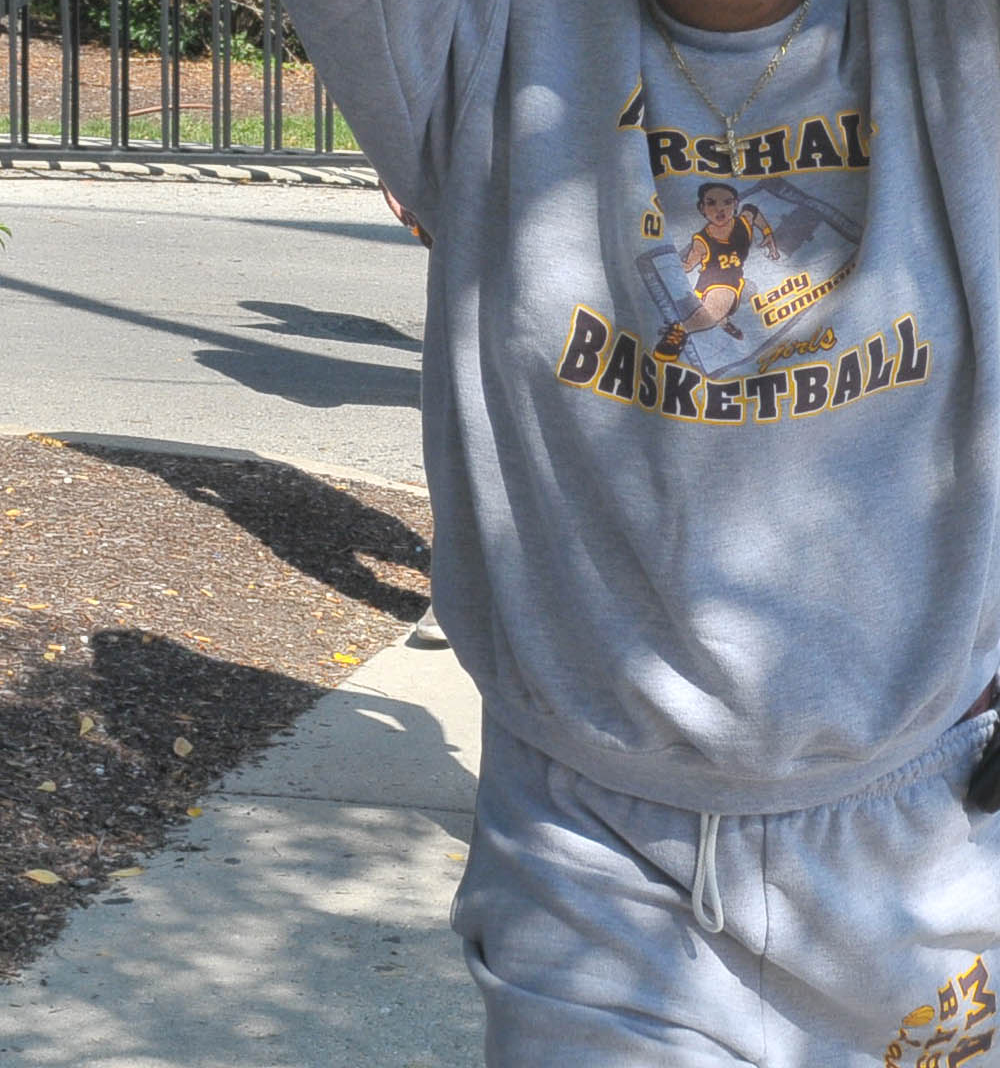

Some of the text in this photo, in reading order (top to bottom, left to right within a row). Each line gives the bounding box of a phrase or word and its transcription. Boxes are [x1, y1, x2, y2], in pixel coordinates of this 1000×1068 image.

[718, 252, 741, 270] 24
[751, 272, 811, 313] Lady
[557, 304, 932, 426] BASKETBALL
